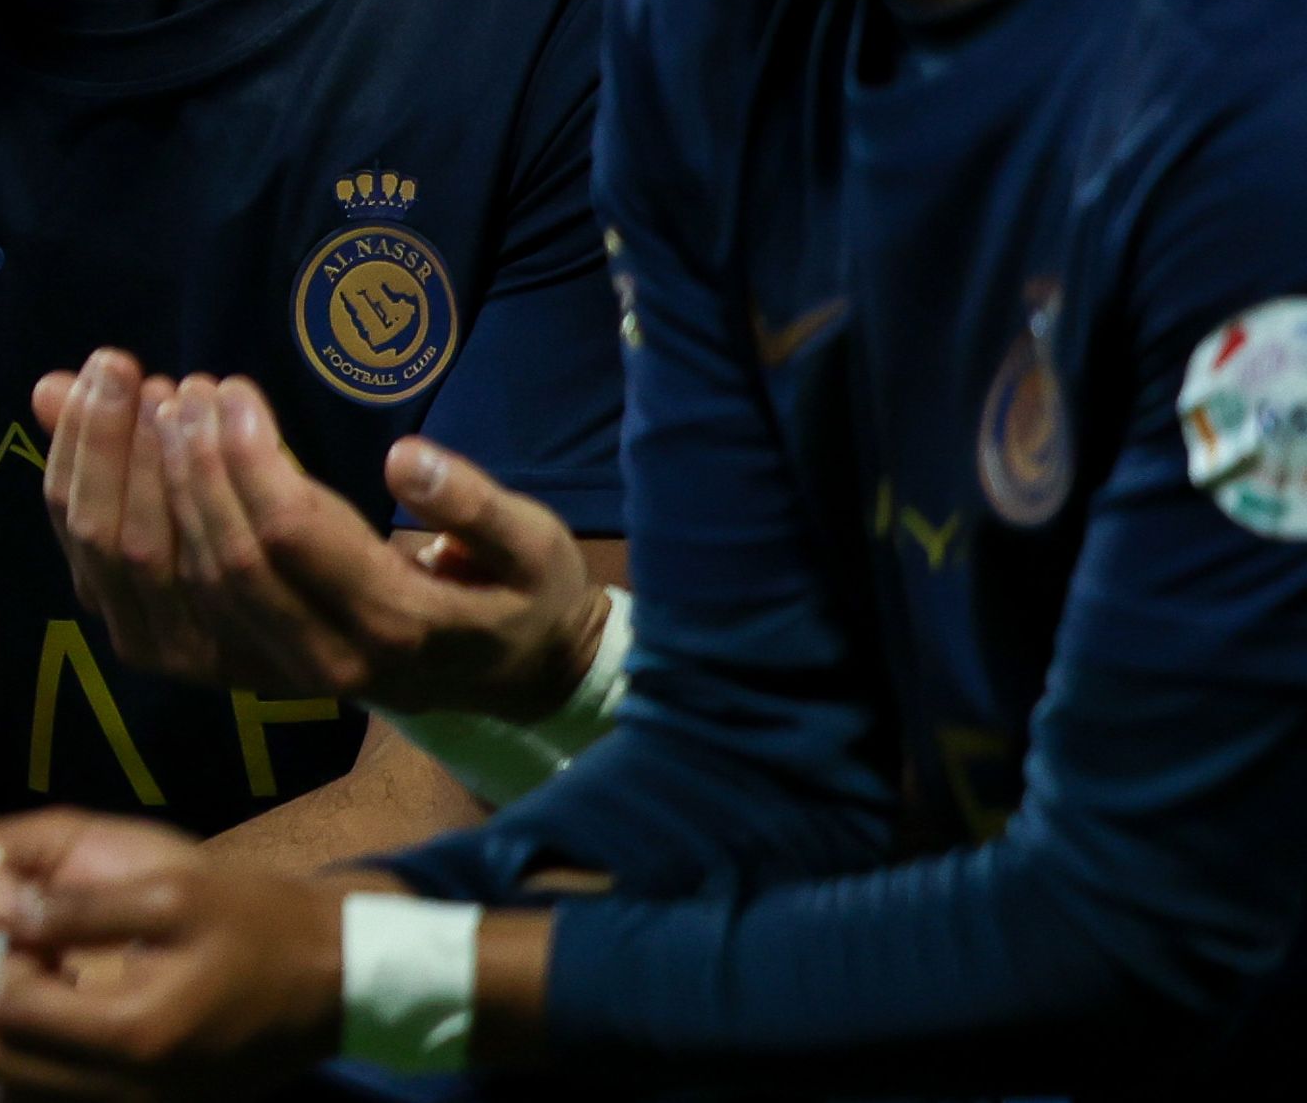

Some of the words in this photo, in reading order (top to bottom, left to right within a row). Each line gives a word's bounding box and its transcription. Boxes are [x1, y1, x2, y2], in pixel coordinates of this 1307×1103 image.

[323, 251, 354, 283] AL
[355, 237, 433, 285] NASSR
[322, 344, 398, 386] FOOTBALL
[403, 345, 438, 380] CLUB
